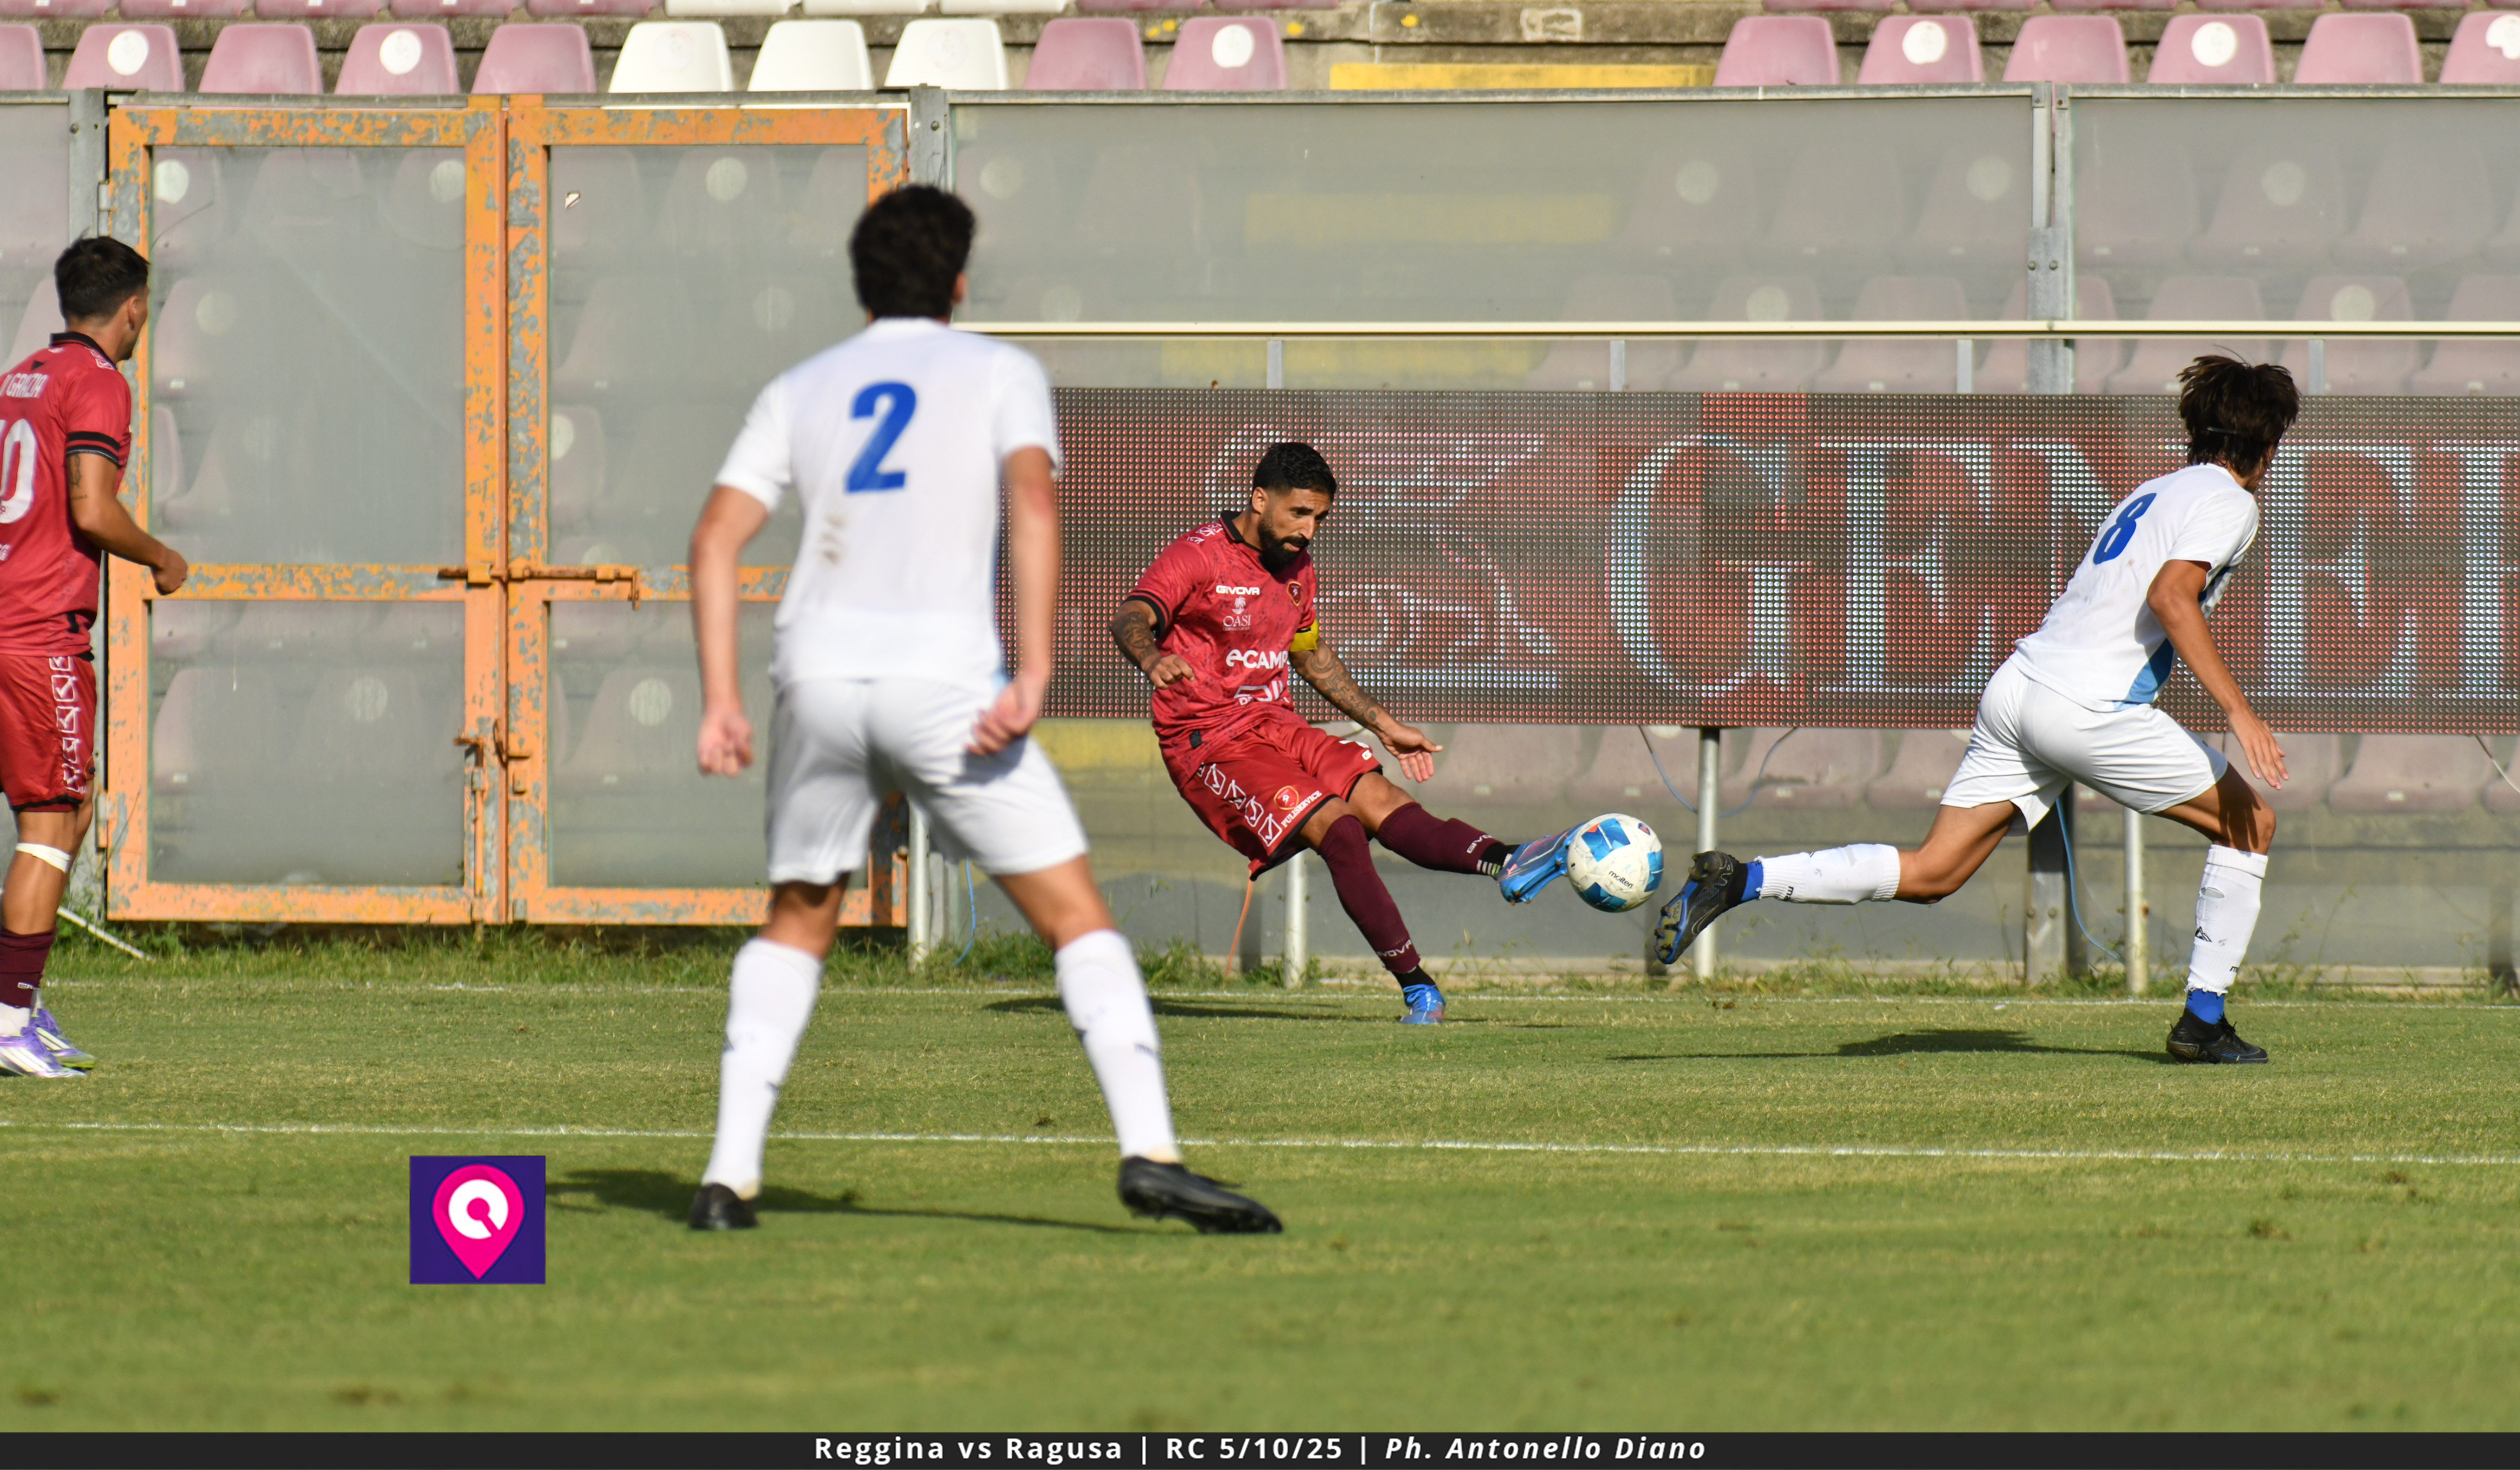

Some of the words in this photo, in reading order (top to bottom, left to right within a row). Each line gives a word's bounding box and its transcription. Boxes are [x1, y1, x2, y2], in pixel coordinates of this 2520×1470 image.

[6, 373, 48, 398] GRAZIA
[844, 381, 917, 494] 2
[2093, 492, 2157, 565] 8
[1216, 585, 1260, 595] GIVOVA
[1223, 615, 1251, 627] OASI
[1280, 790, 1323, 828] PULISERVICE
[1608, 871, 1634, 888] molten
